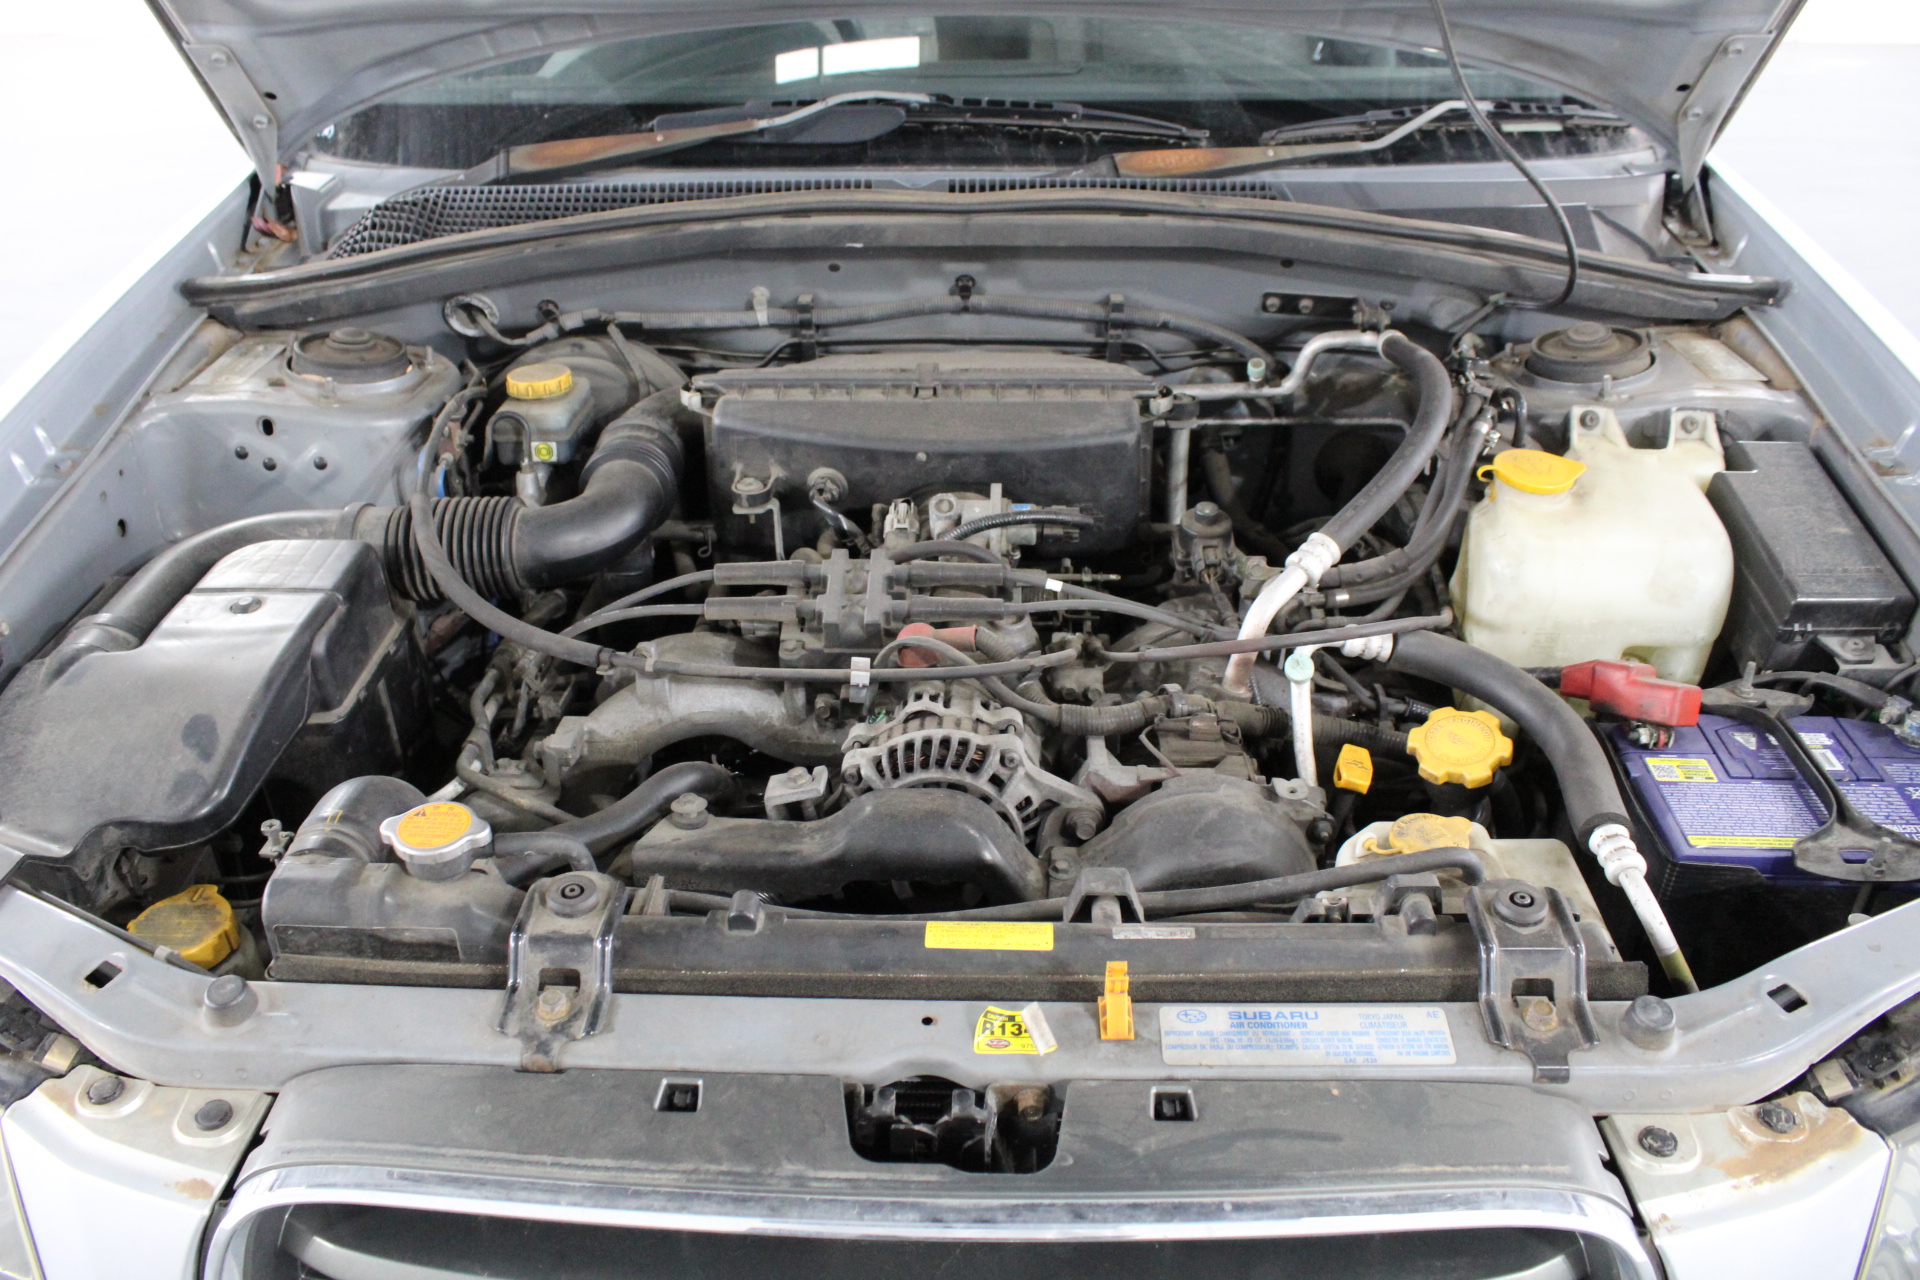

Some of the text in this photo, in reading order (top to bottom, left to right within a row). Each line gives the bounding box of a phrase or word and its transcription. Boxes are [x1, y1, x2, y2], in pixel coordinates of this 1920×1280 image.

[1228, 1011, 1319, 1021] SUBARU
[1426, 1011, 1440, 1019] AE
[982, 1020, 1028, 1036] R13
